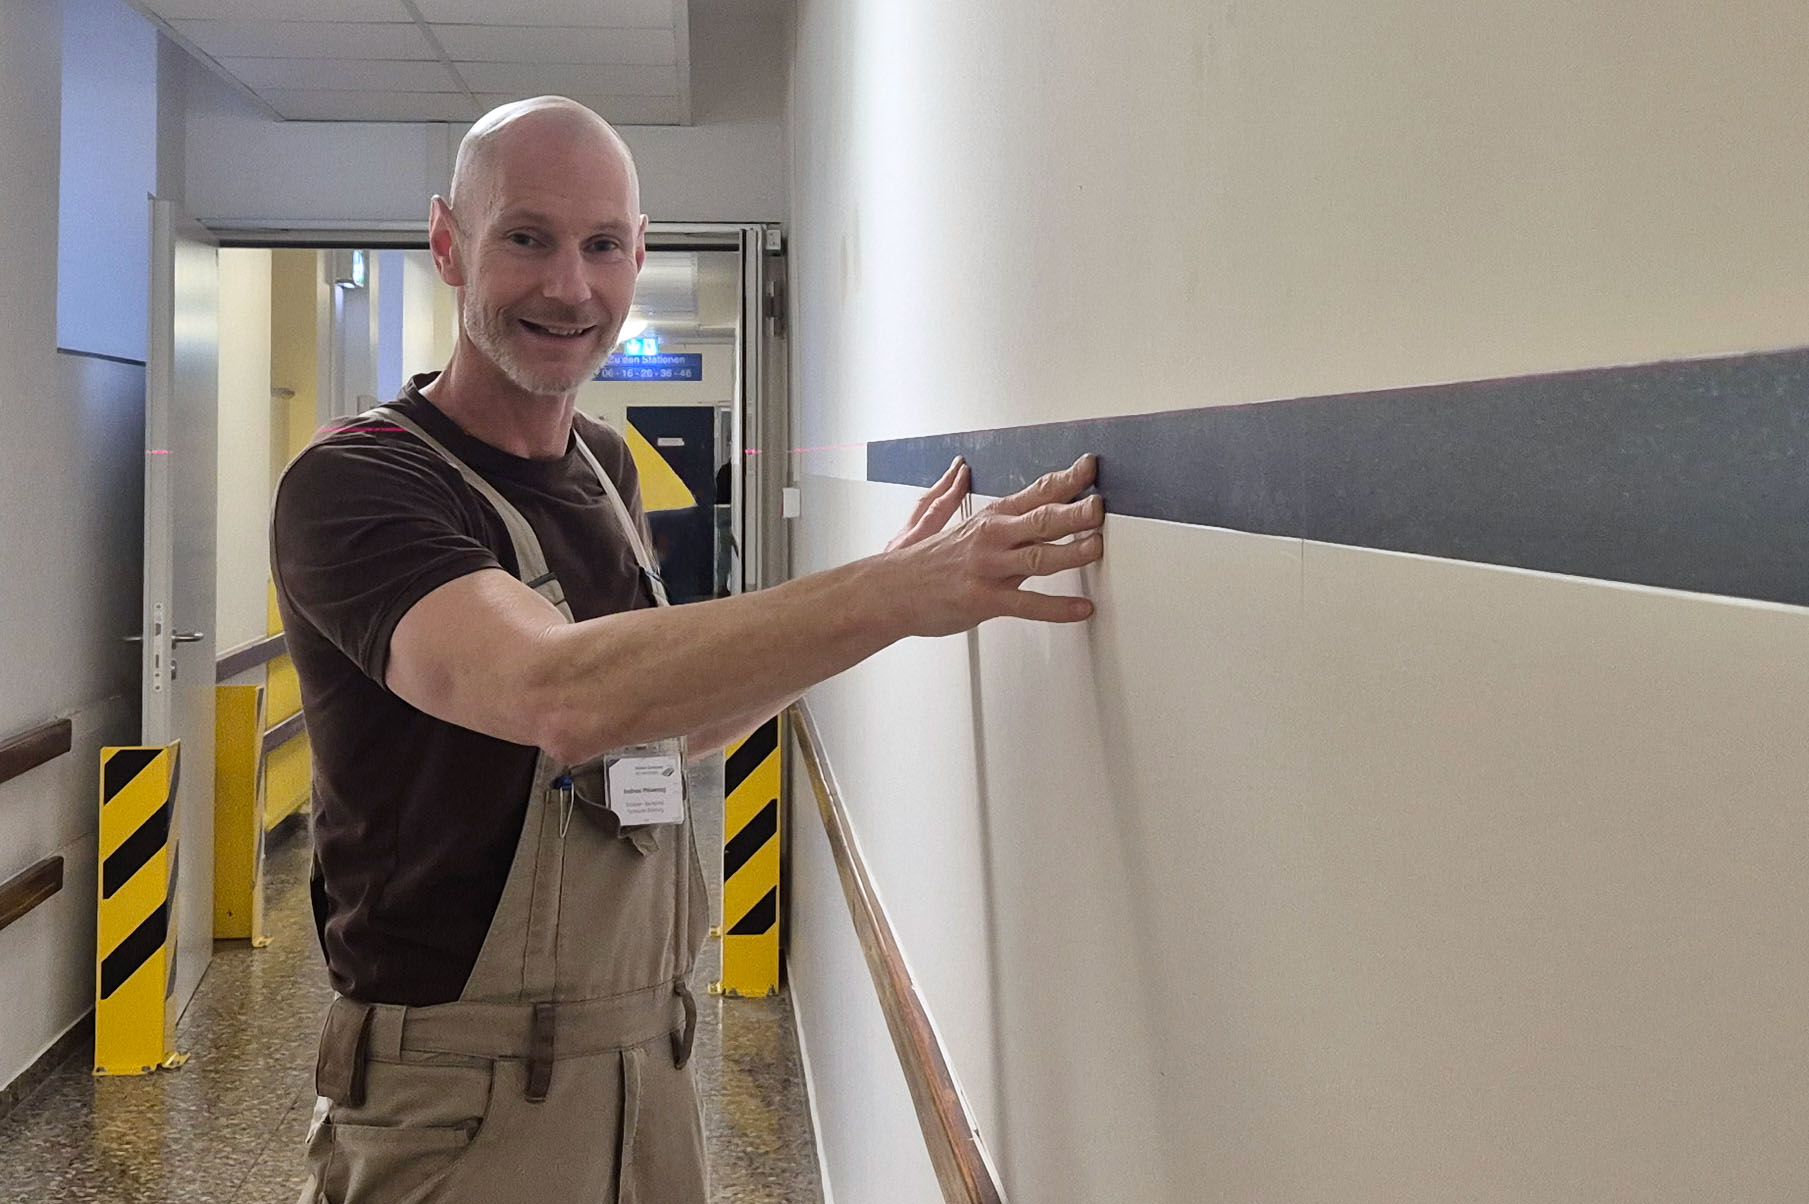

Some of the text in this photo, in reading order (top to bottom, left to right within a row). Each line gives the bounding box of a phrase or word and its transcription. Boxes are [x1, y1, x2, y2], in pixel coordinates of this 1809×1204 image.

[642, 355, 686, 364] Stationen
[602, 369, 613, 377] 06
[623, 368, 633, 377] 16
[661, 368, 672, 377] 36
